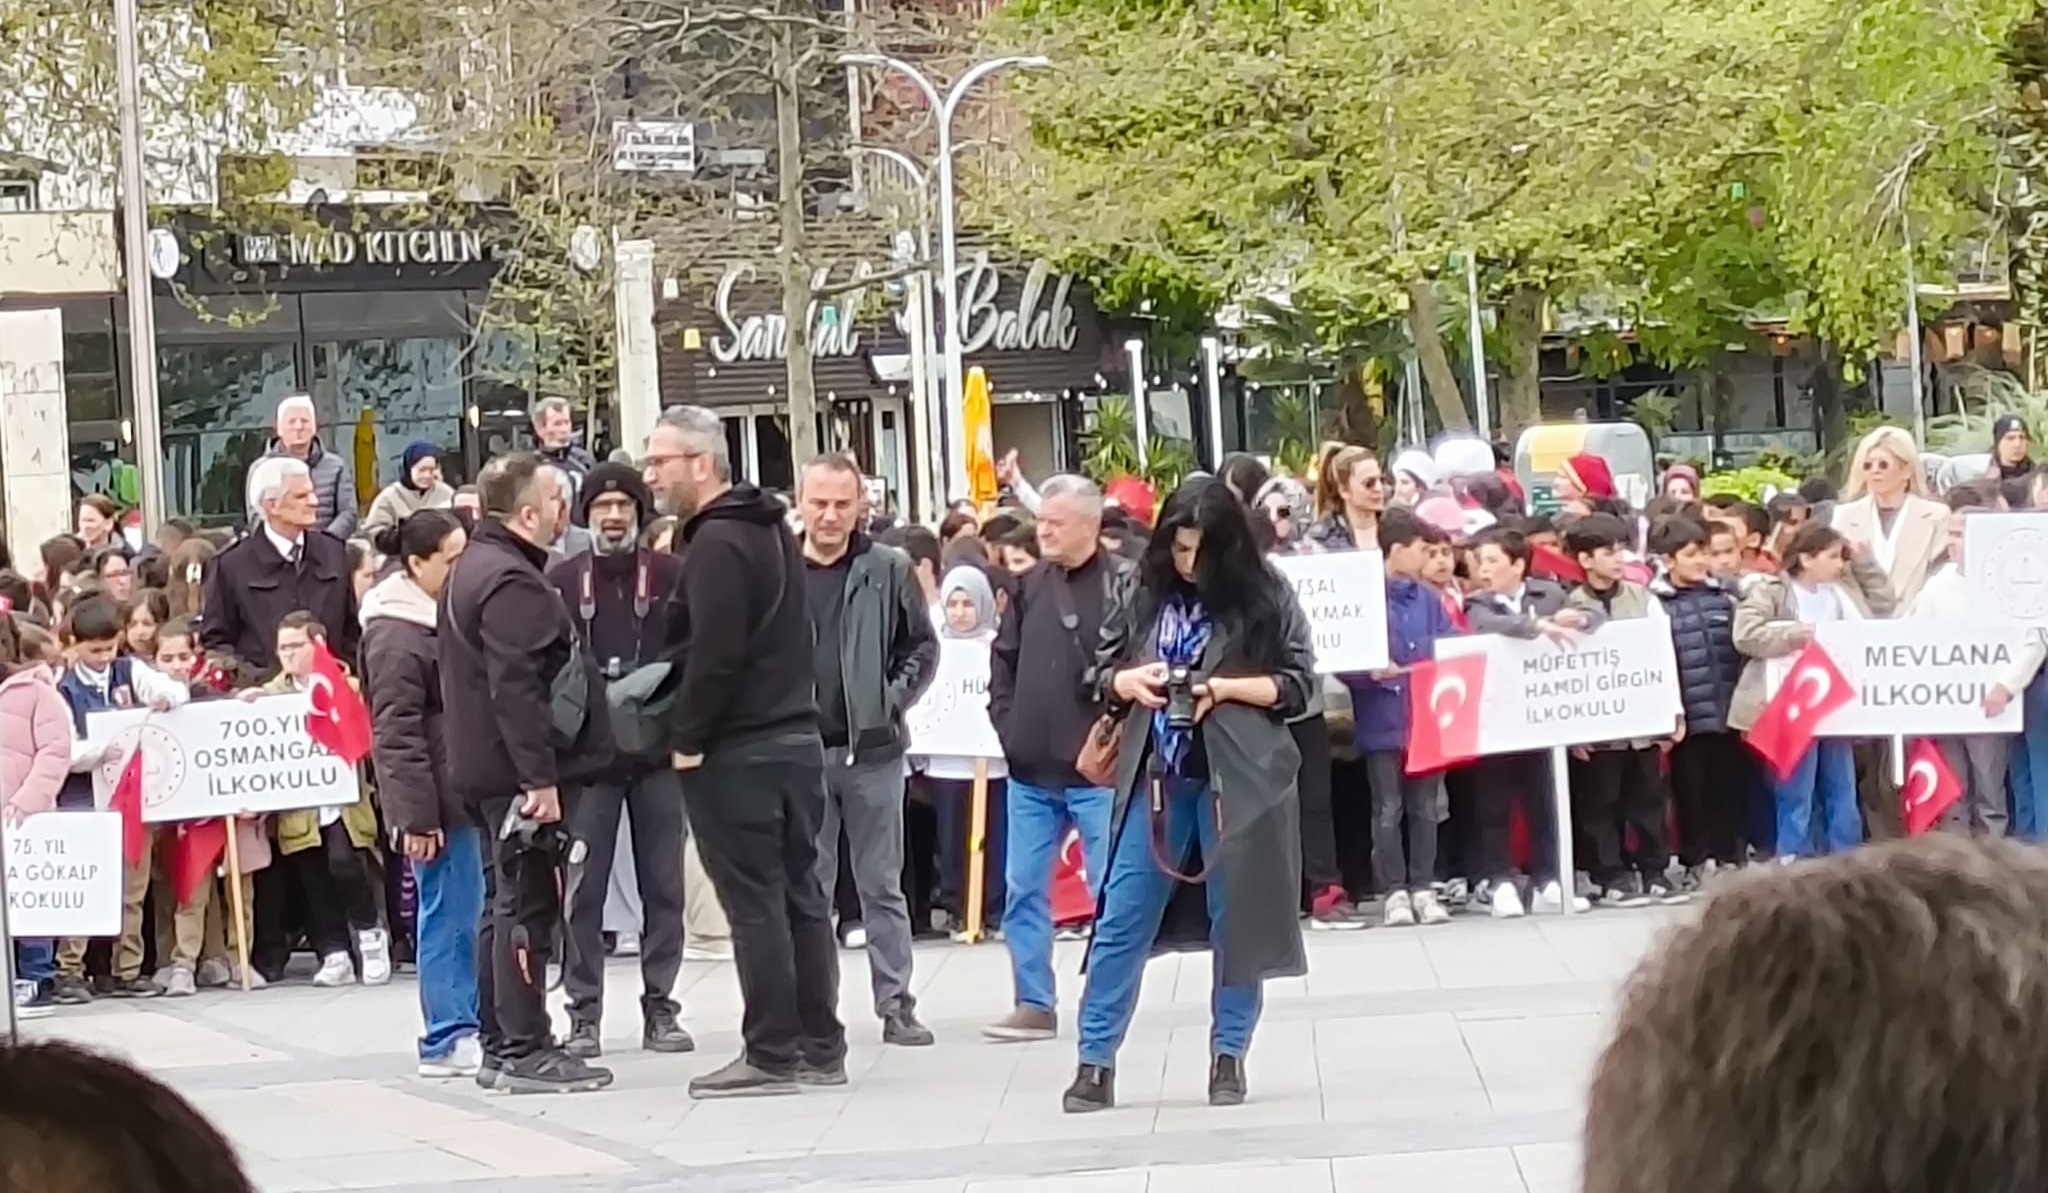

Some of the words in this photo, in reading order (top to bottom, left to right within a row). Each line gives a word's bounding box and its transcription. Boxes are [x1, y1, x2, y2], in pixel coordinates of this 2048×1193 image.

[290, 230, 356, 264] MAD
[366, 230, 482, 263] KITCHEN
[1523, 647, 1621, 674] MÜFETTİŞ
[1865, 643, 2012, 667] MEVLANA
[1525, 672, 1590, 699] HAMDİ
[1596, 667, 1663, 692] GİRGİN
[1526, 698, 1625, 724] İLKOKULU
[208, 765, 337, 797] İLKOKULU
[13, 838, 38, 855] 75.
[44, 838, 67, 855] YIL
[25, 861, 98, 881] GÖKALP
